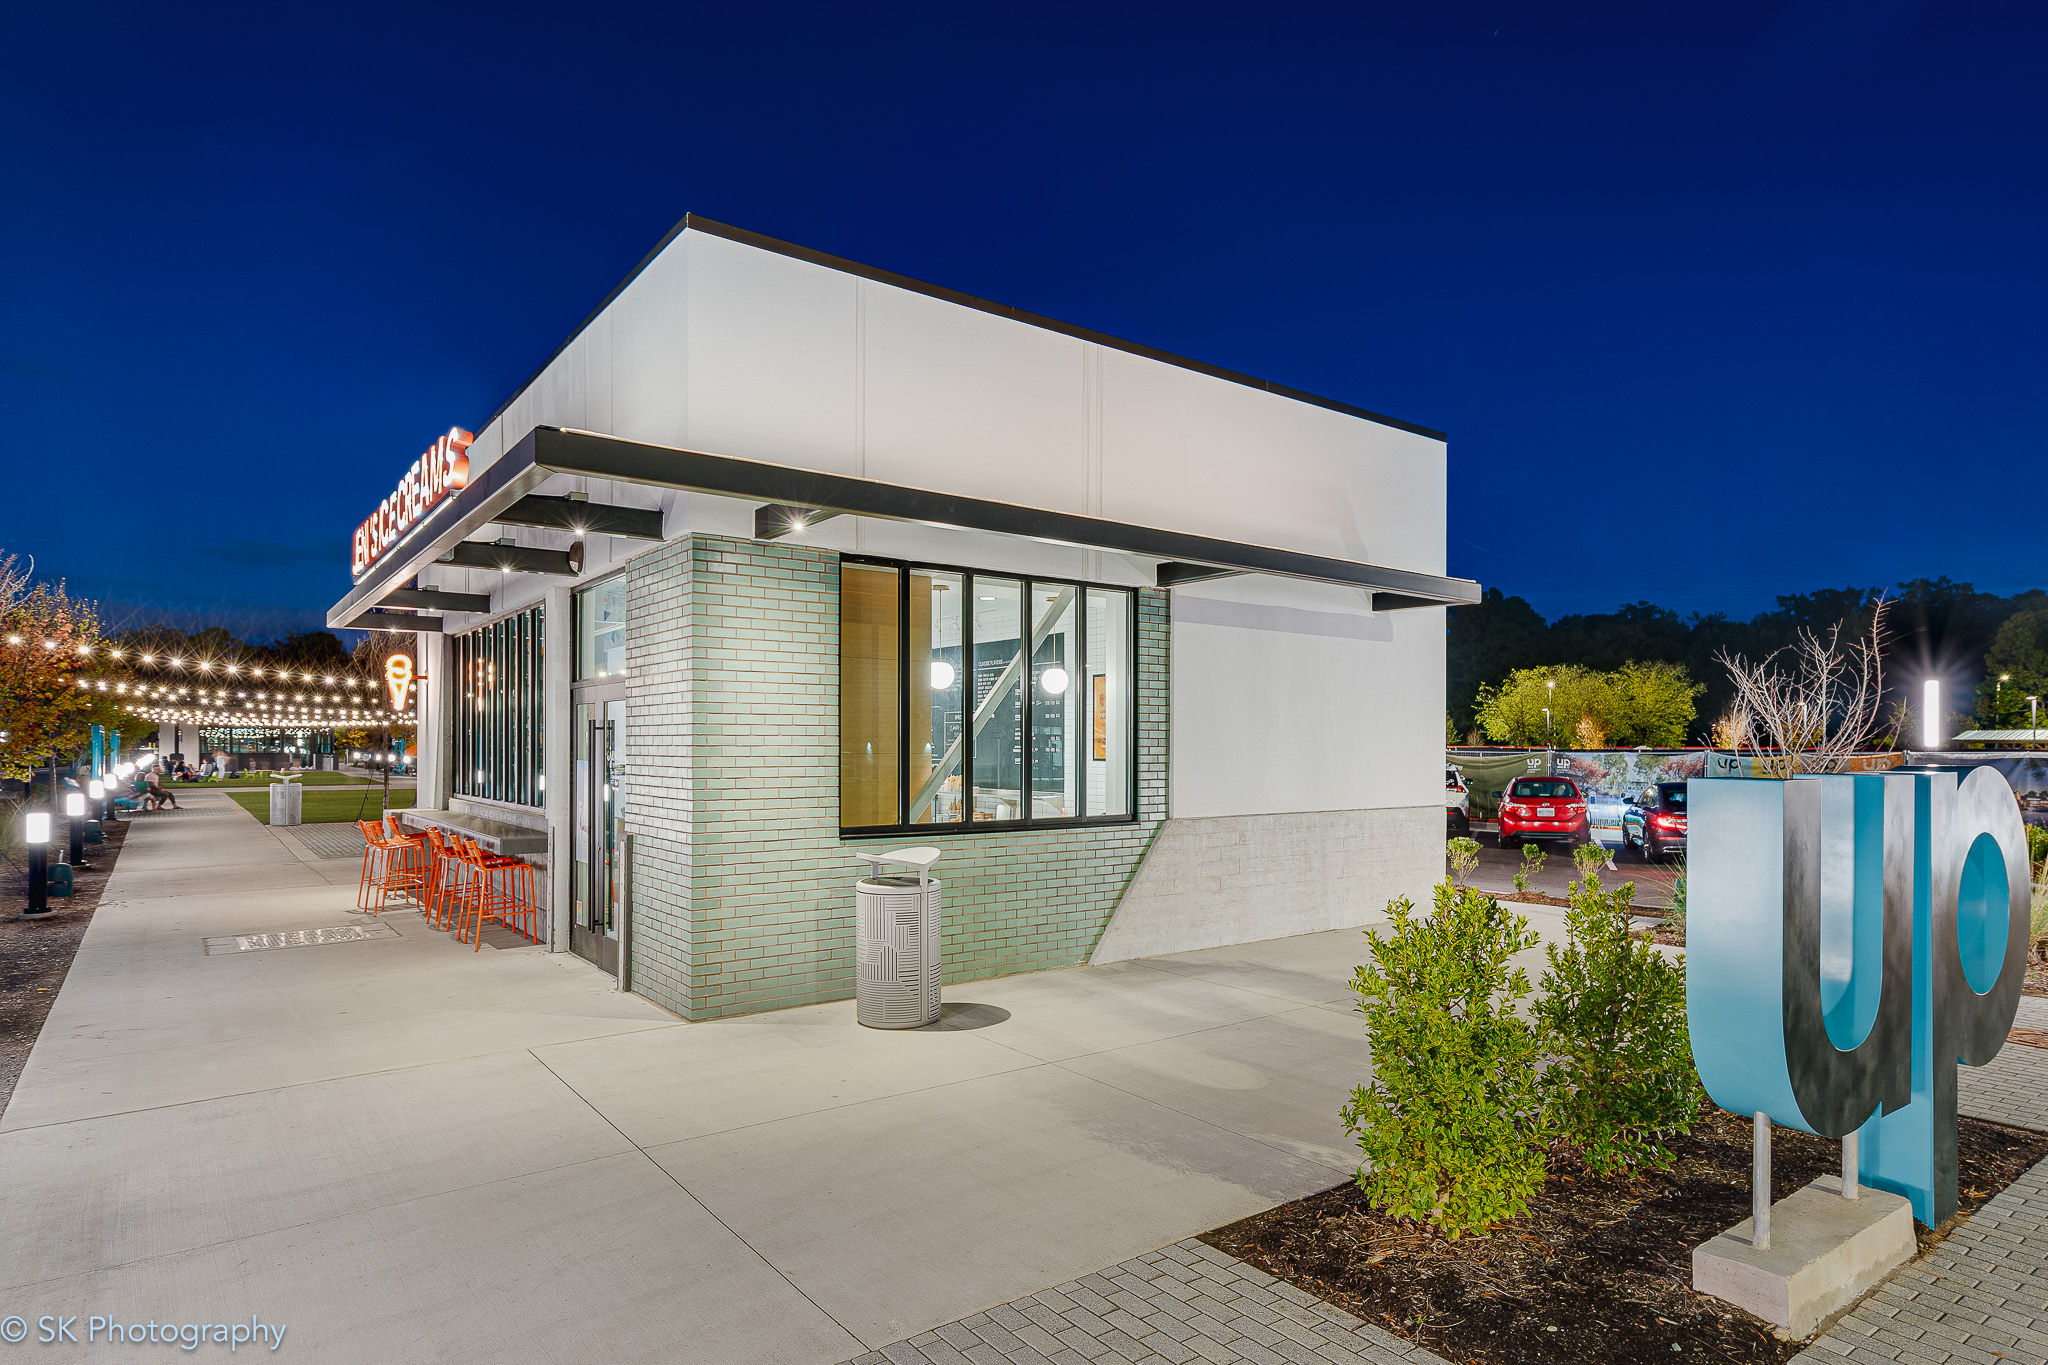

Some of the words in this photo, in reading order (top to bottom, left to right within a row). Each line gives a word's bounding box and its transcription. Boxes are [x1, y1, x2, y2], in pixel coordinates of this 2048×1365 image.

[396, 426, 464, 531] CREAMS
[1527, 758, 1541, 768] up
[1557, 758, 1570, 769] up
